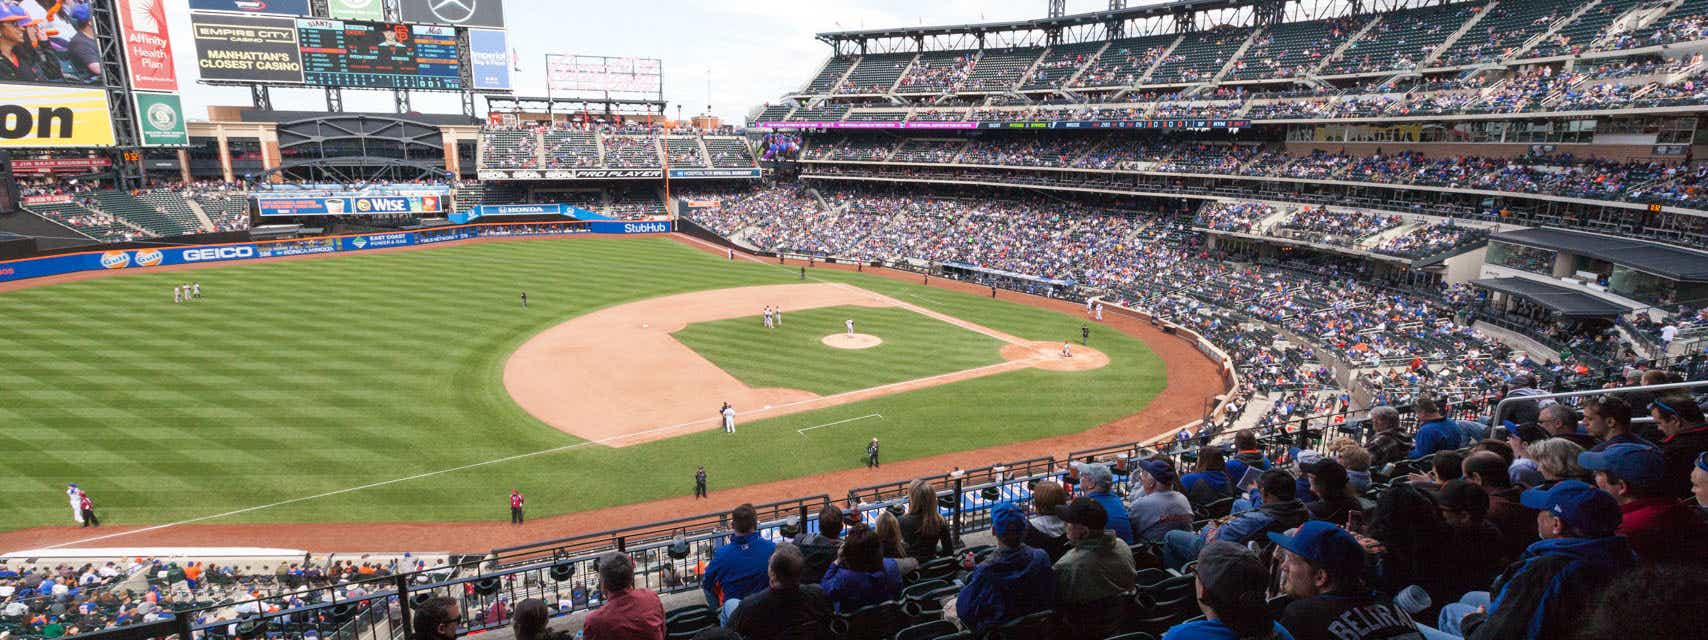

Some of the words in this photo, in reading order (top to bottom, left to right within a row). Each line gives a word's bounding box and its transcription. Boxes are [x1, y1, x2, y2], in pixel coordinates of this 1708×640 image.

[307, 21, 333, 29] GIANTS
[200, 28, 255, 38] EMPIRE
[258, 31, 290, 39] CITY
[130, 32, 167, 49] Affinity
[134, 46, 167, 59] Health
[207, 50, 290, 62] MANHATTAN'S
[142, 58, 163, 70] Plan
[200, 59, 254, 70] CLOSEST
[256, 61, 299, 71] CASINO
[372, 199, 406, 211] WISE
[624, 223, 665, 233] StubHub
[104, 254, 128, 266] Gulf
[138, 252, 162, 264] Gulf
[182, 246, 254, 262] GEICO
